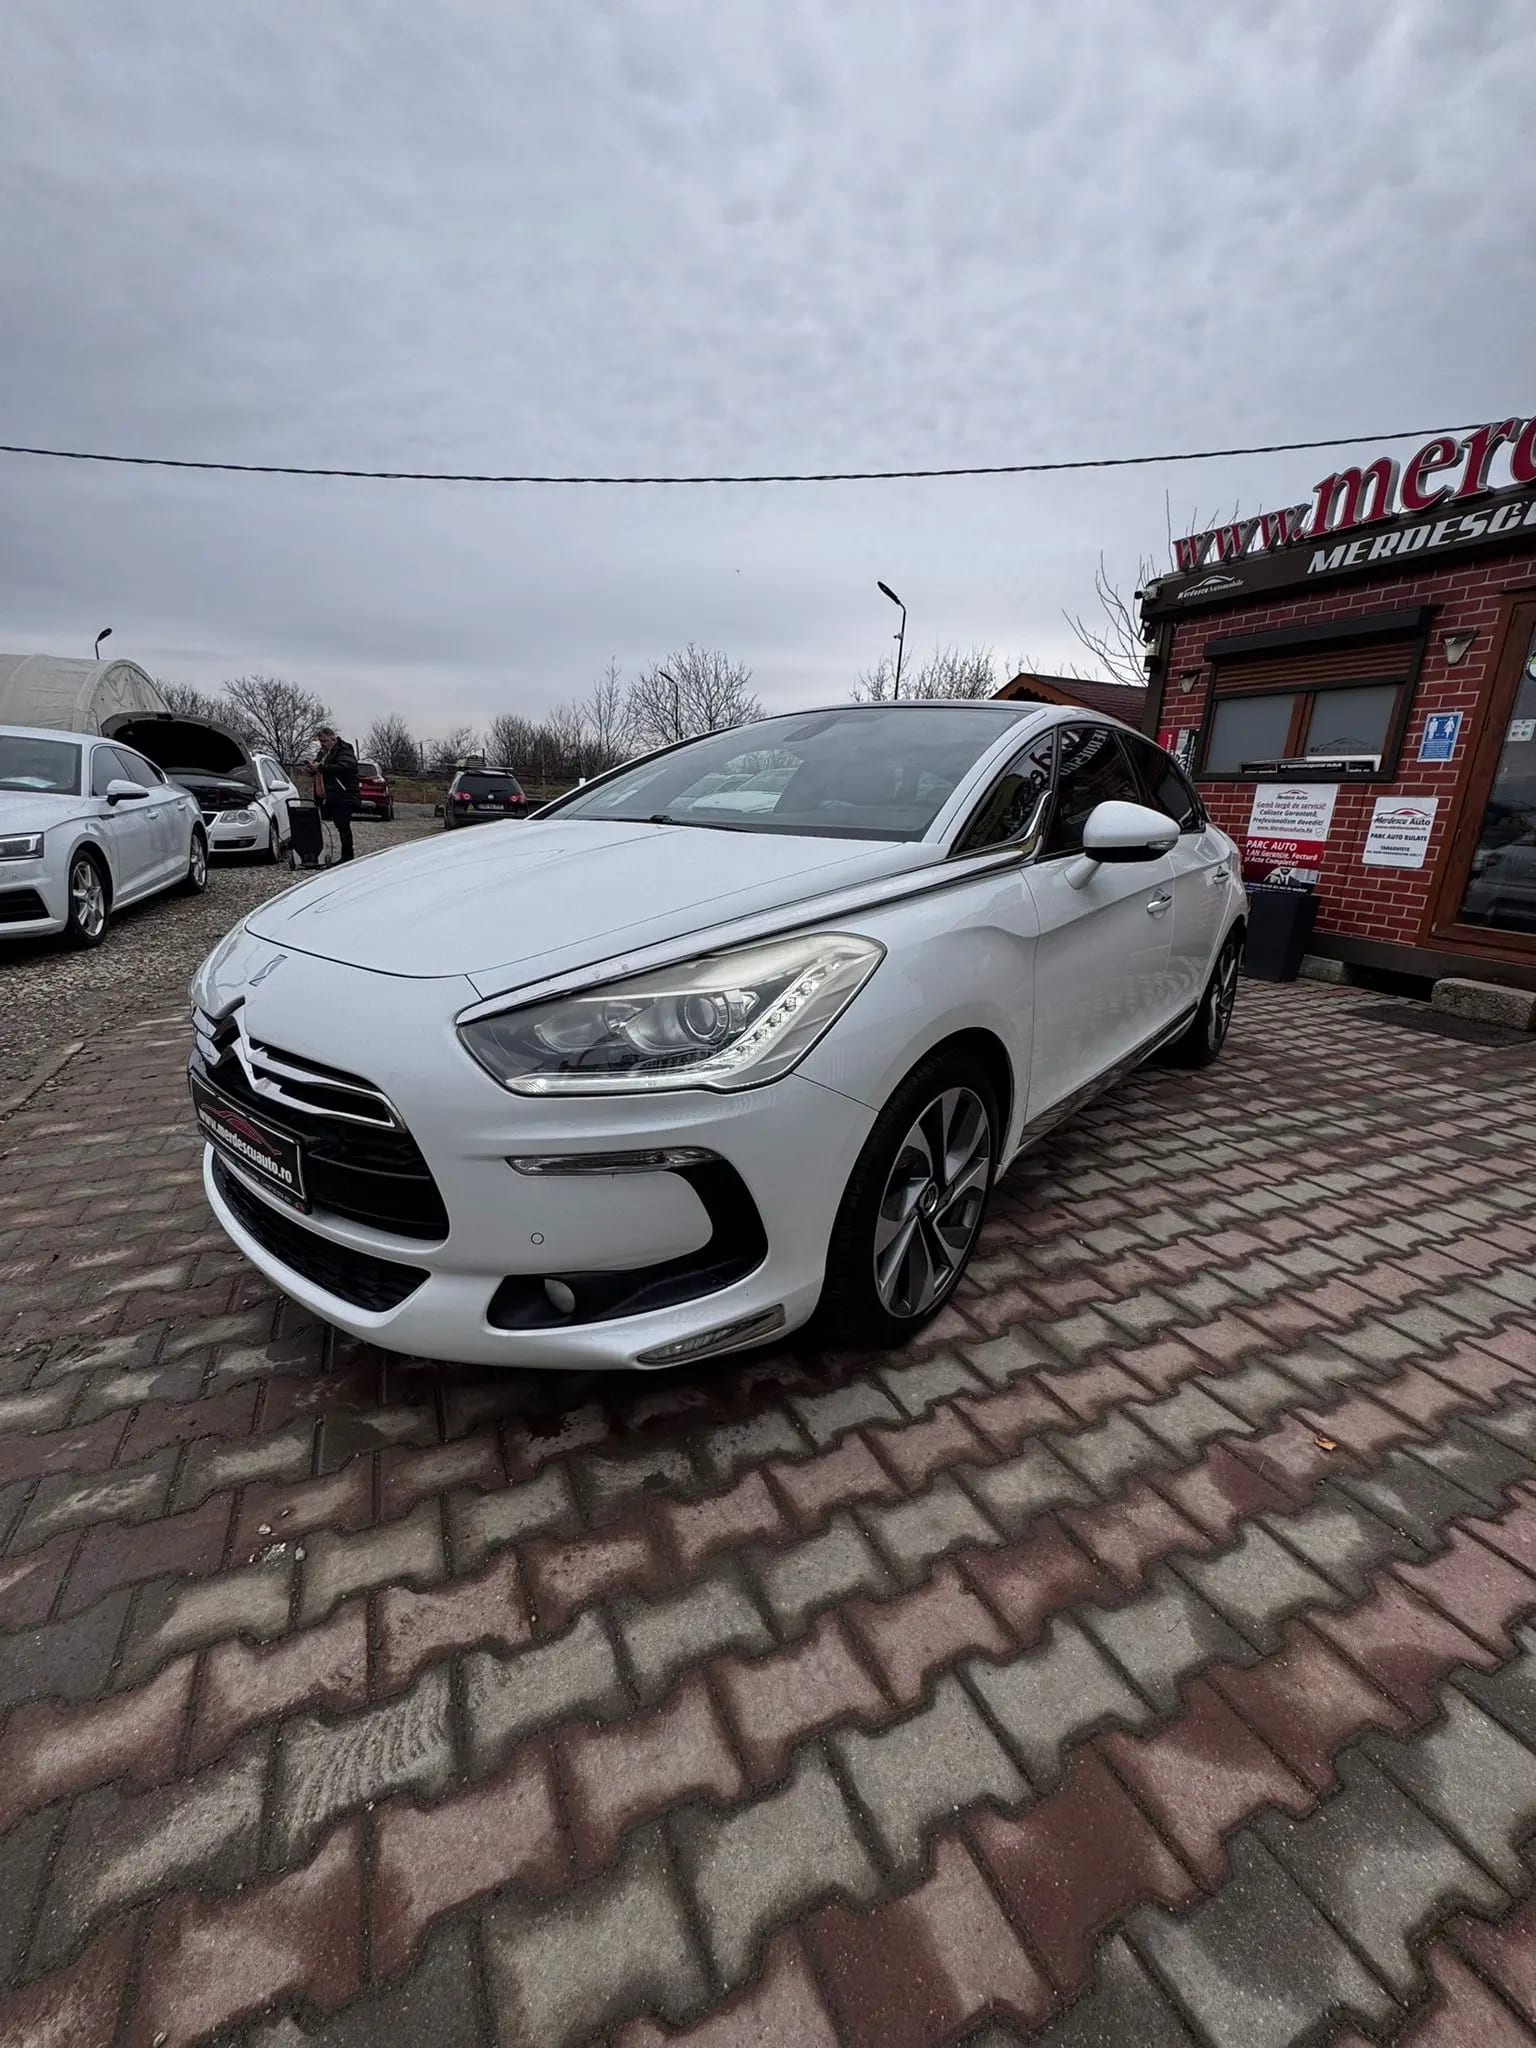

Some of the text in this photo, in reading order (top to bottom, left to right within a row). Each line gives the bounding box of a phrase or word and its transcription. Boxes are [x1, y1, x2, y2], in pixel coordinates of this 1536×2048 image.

[1409, 818, 1431, 826] Auto
[1246, 840, 1297, 851] PARC AUTO
